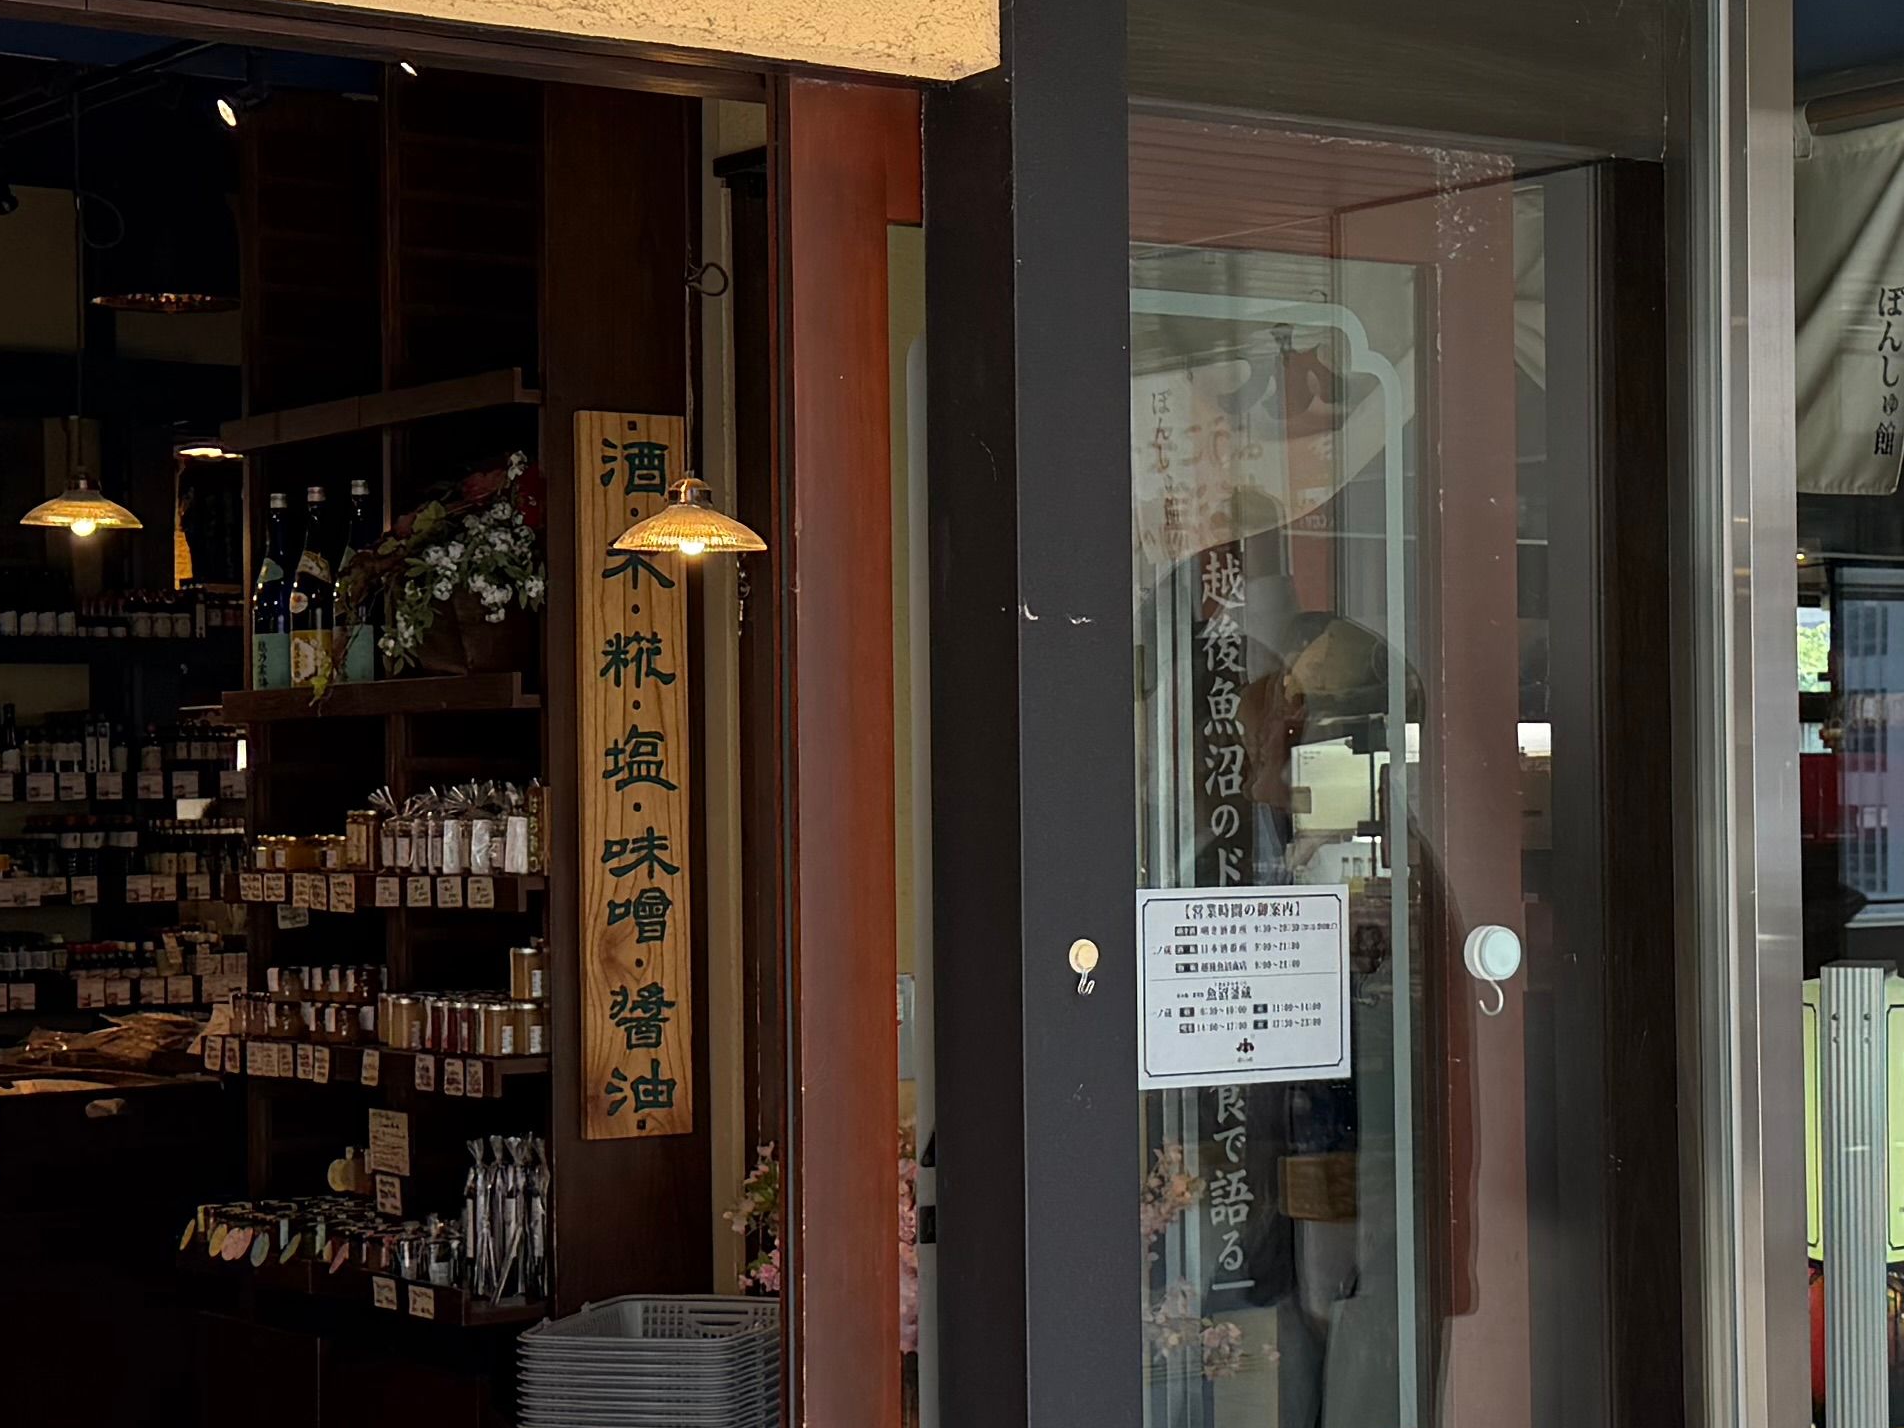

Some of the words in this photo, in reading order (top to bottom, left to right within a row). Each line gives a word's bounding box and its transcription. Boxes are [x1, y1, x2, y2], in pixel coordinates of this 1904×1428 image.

[1185, 901, 1301, 919] 【営業時間の御案内】
